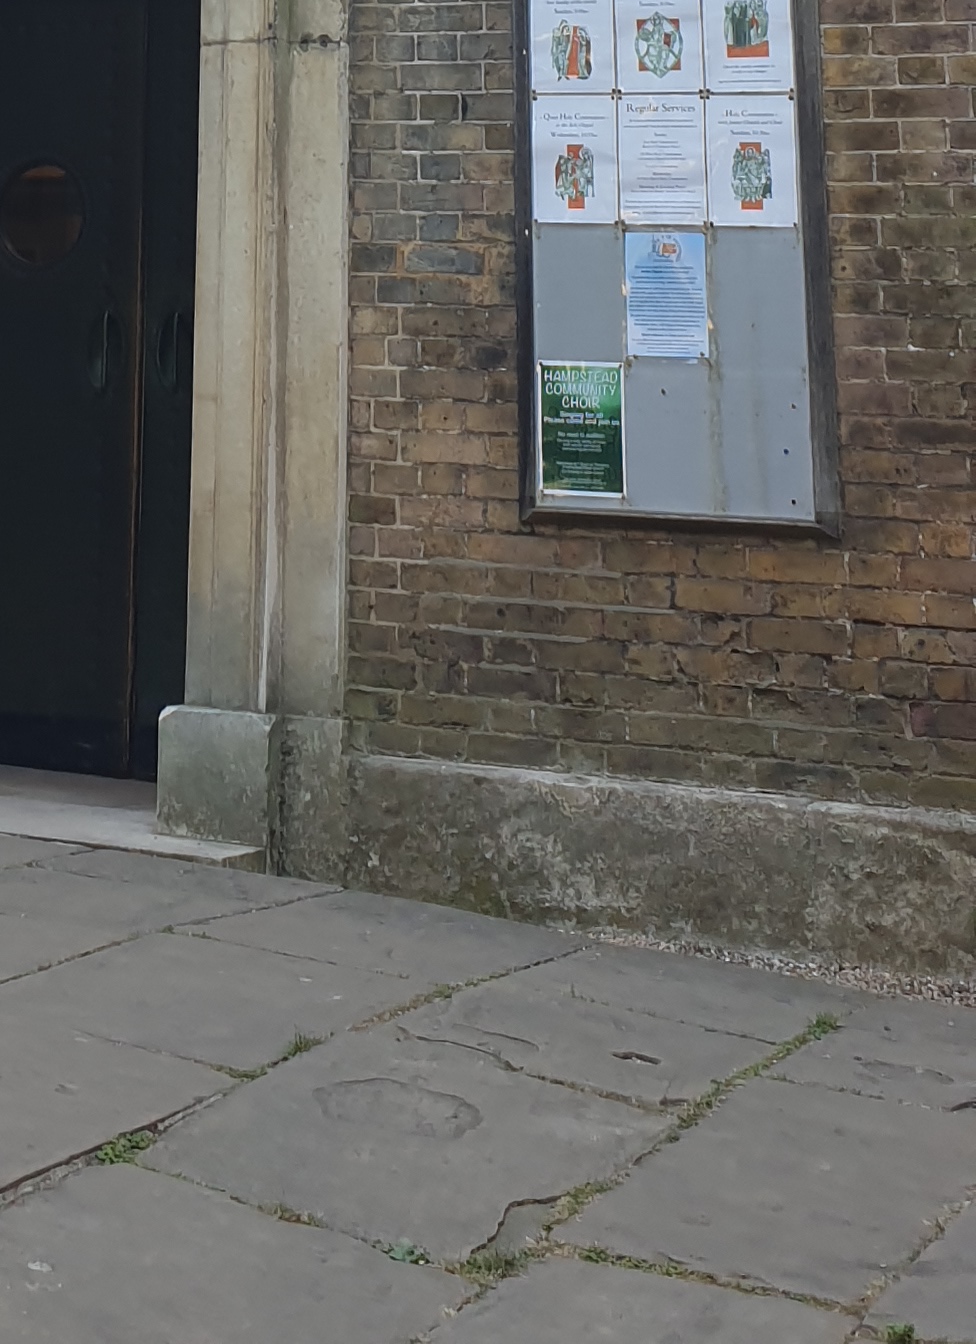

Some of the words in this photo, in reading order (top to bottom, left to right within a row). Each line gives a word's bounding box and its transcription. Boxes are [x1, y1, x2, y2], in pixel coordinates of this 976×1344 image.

[626, 103, 660, 115] Regular
[661, 103, 696, 113] Services
[544, 369, 618, 384] HAMPSTEAD
[545, 382, 617, 396] COMMUNITY
[562, 395, 600, 409] CHOIR
